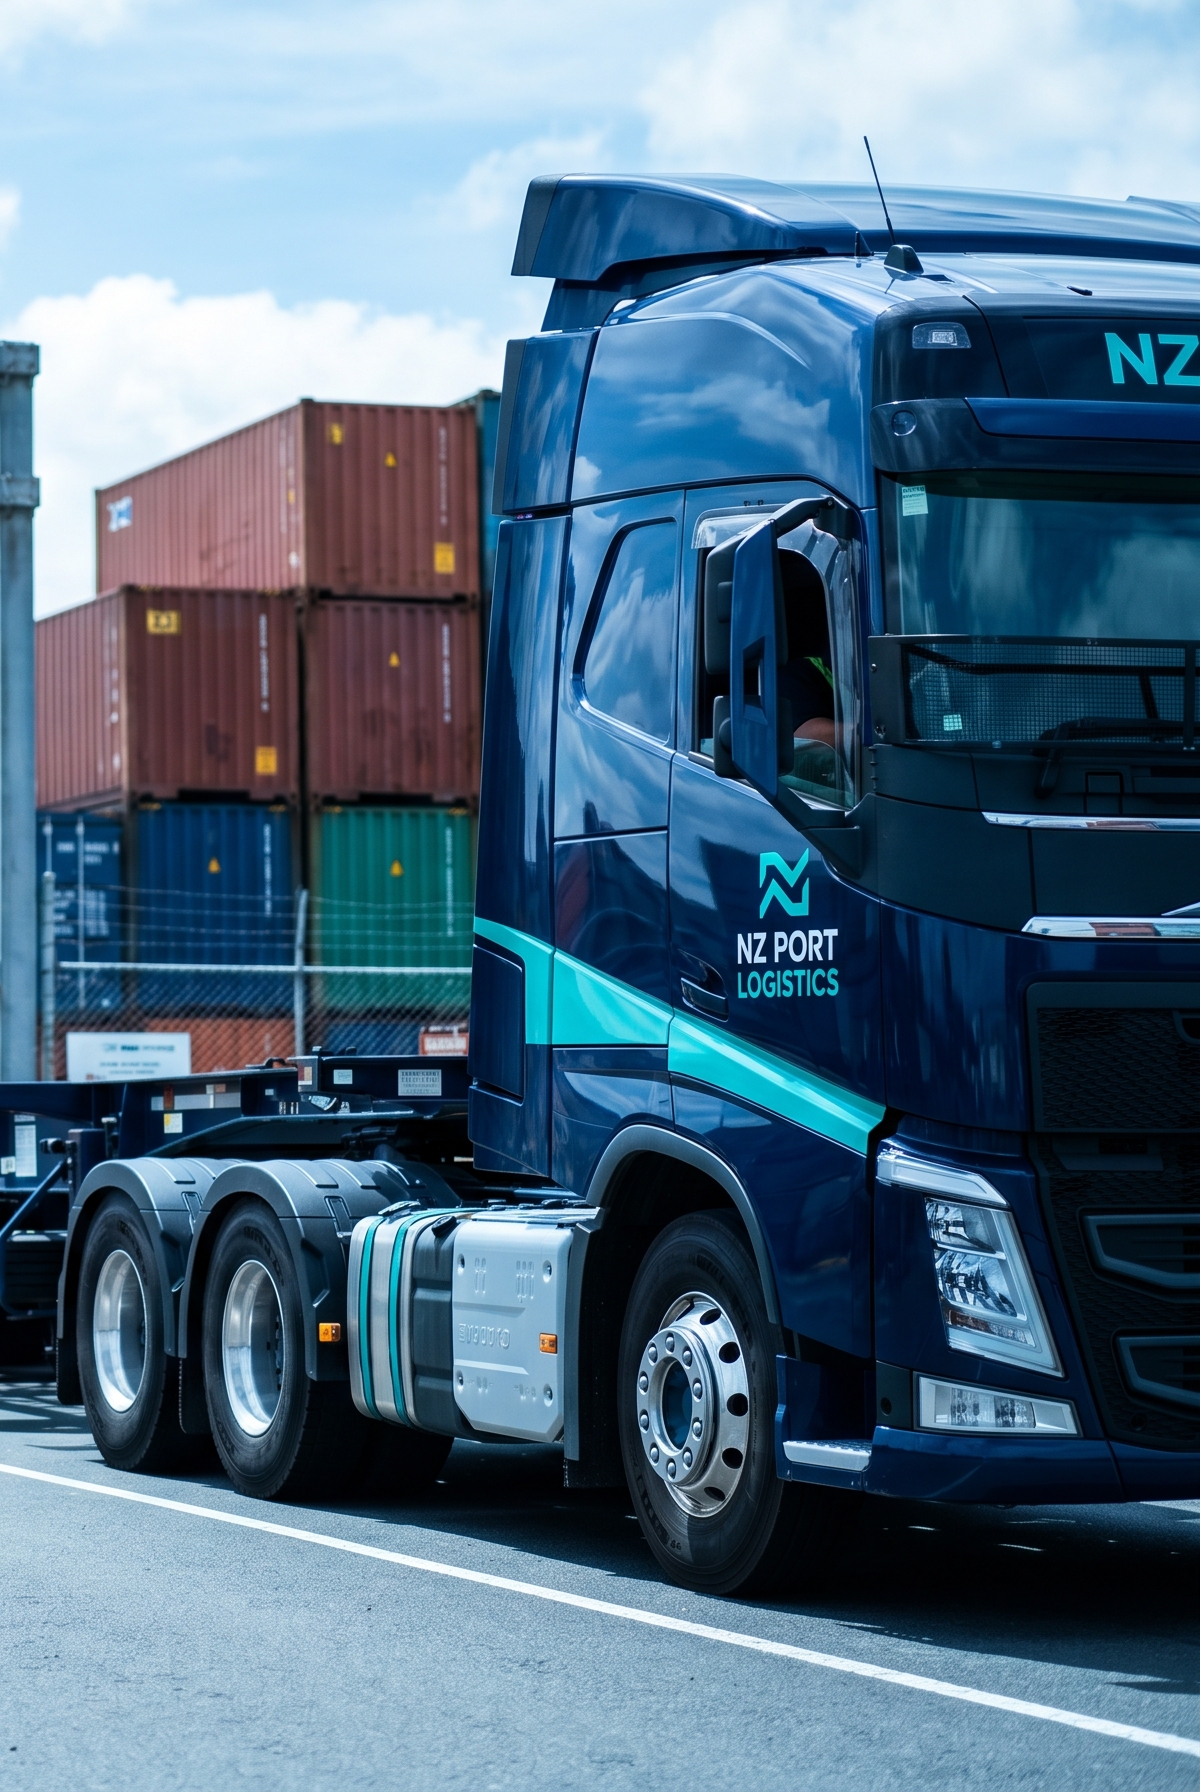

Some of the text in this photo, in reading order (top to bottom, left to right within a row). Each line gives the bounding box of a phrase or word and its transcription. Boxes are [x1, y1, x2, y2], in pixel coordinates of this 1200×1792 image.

[1104, 332, 1200, 387] NZ
[737, 928, 839, 965] NZ PORT
[737, 967, 839, 999] LOGISTICS
